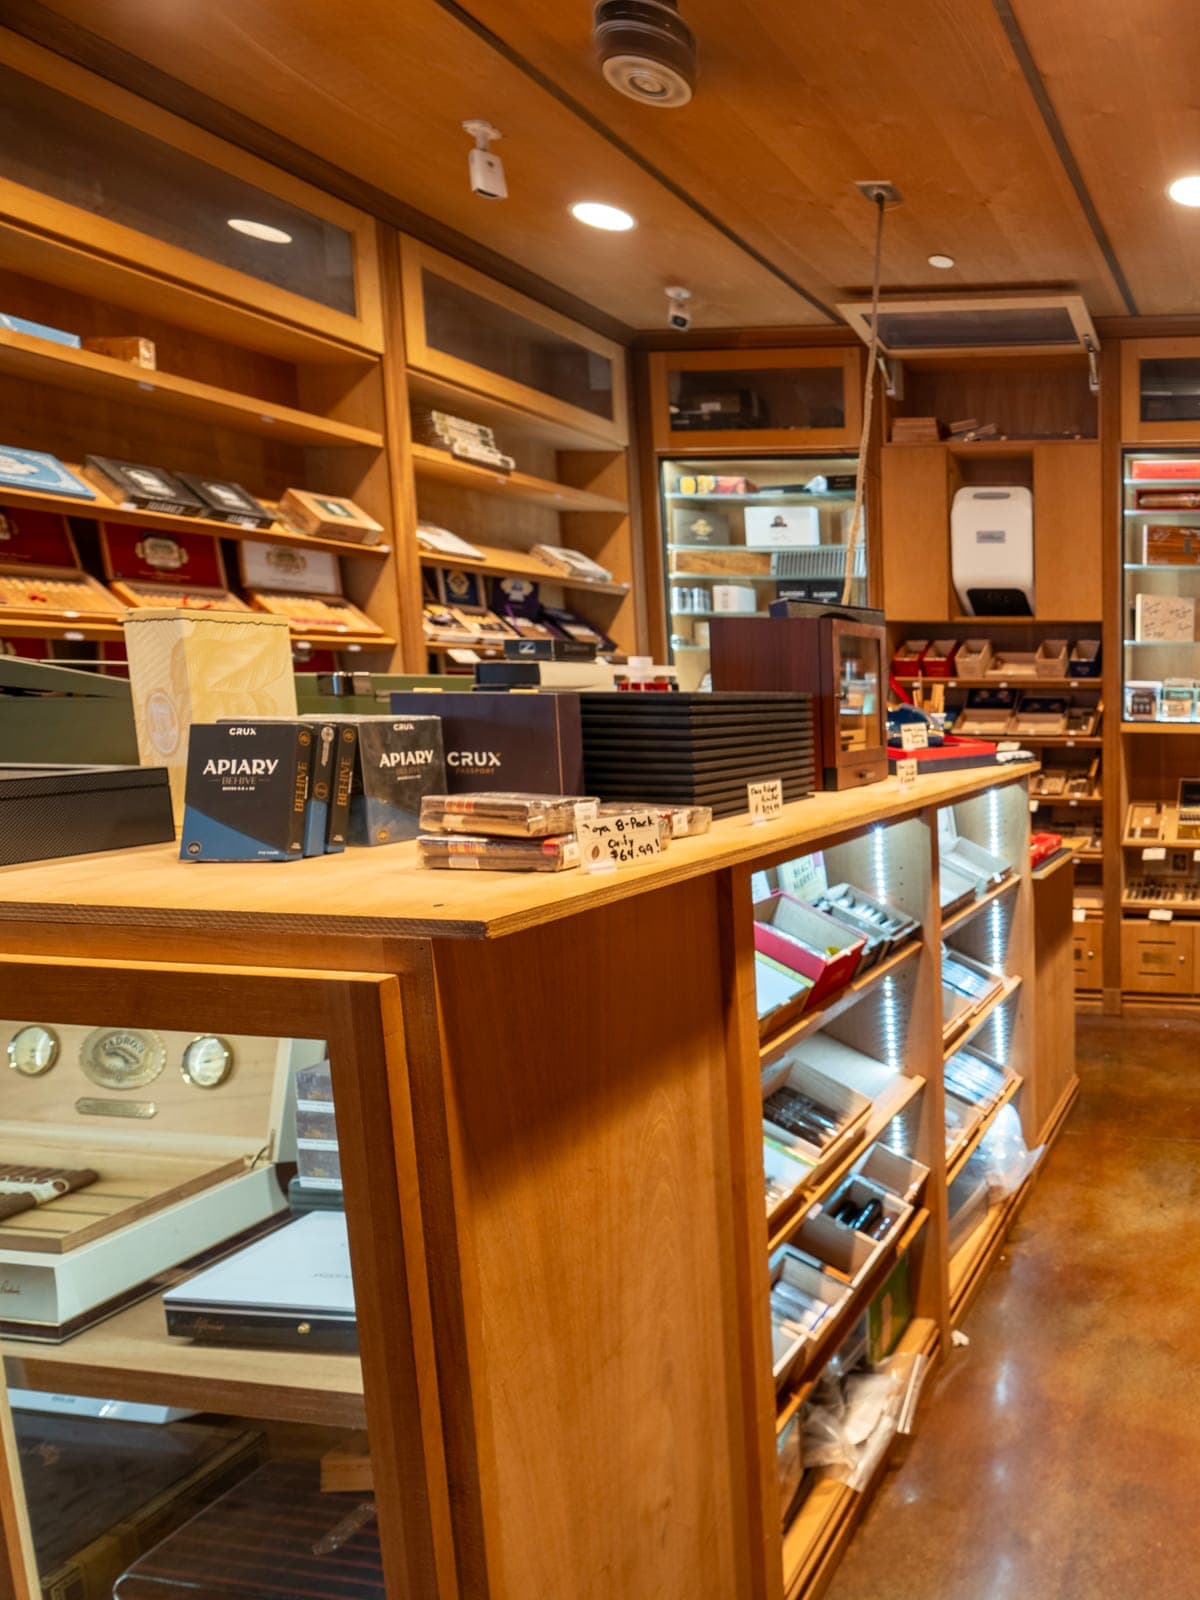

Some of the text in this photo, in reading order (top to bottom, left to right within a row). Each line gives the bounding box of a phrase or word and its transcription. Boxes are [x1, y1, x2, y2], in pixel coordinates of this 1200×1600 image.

[228, 727, 257, 736] CRUX
[393, 723, 415, 731] CRUX
[202, 759, 279, 775] APIARY
[379, 750, 434, 768] APIARY
[447, 751, 502, 767] CRUX
